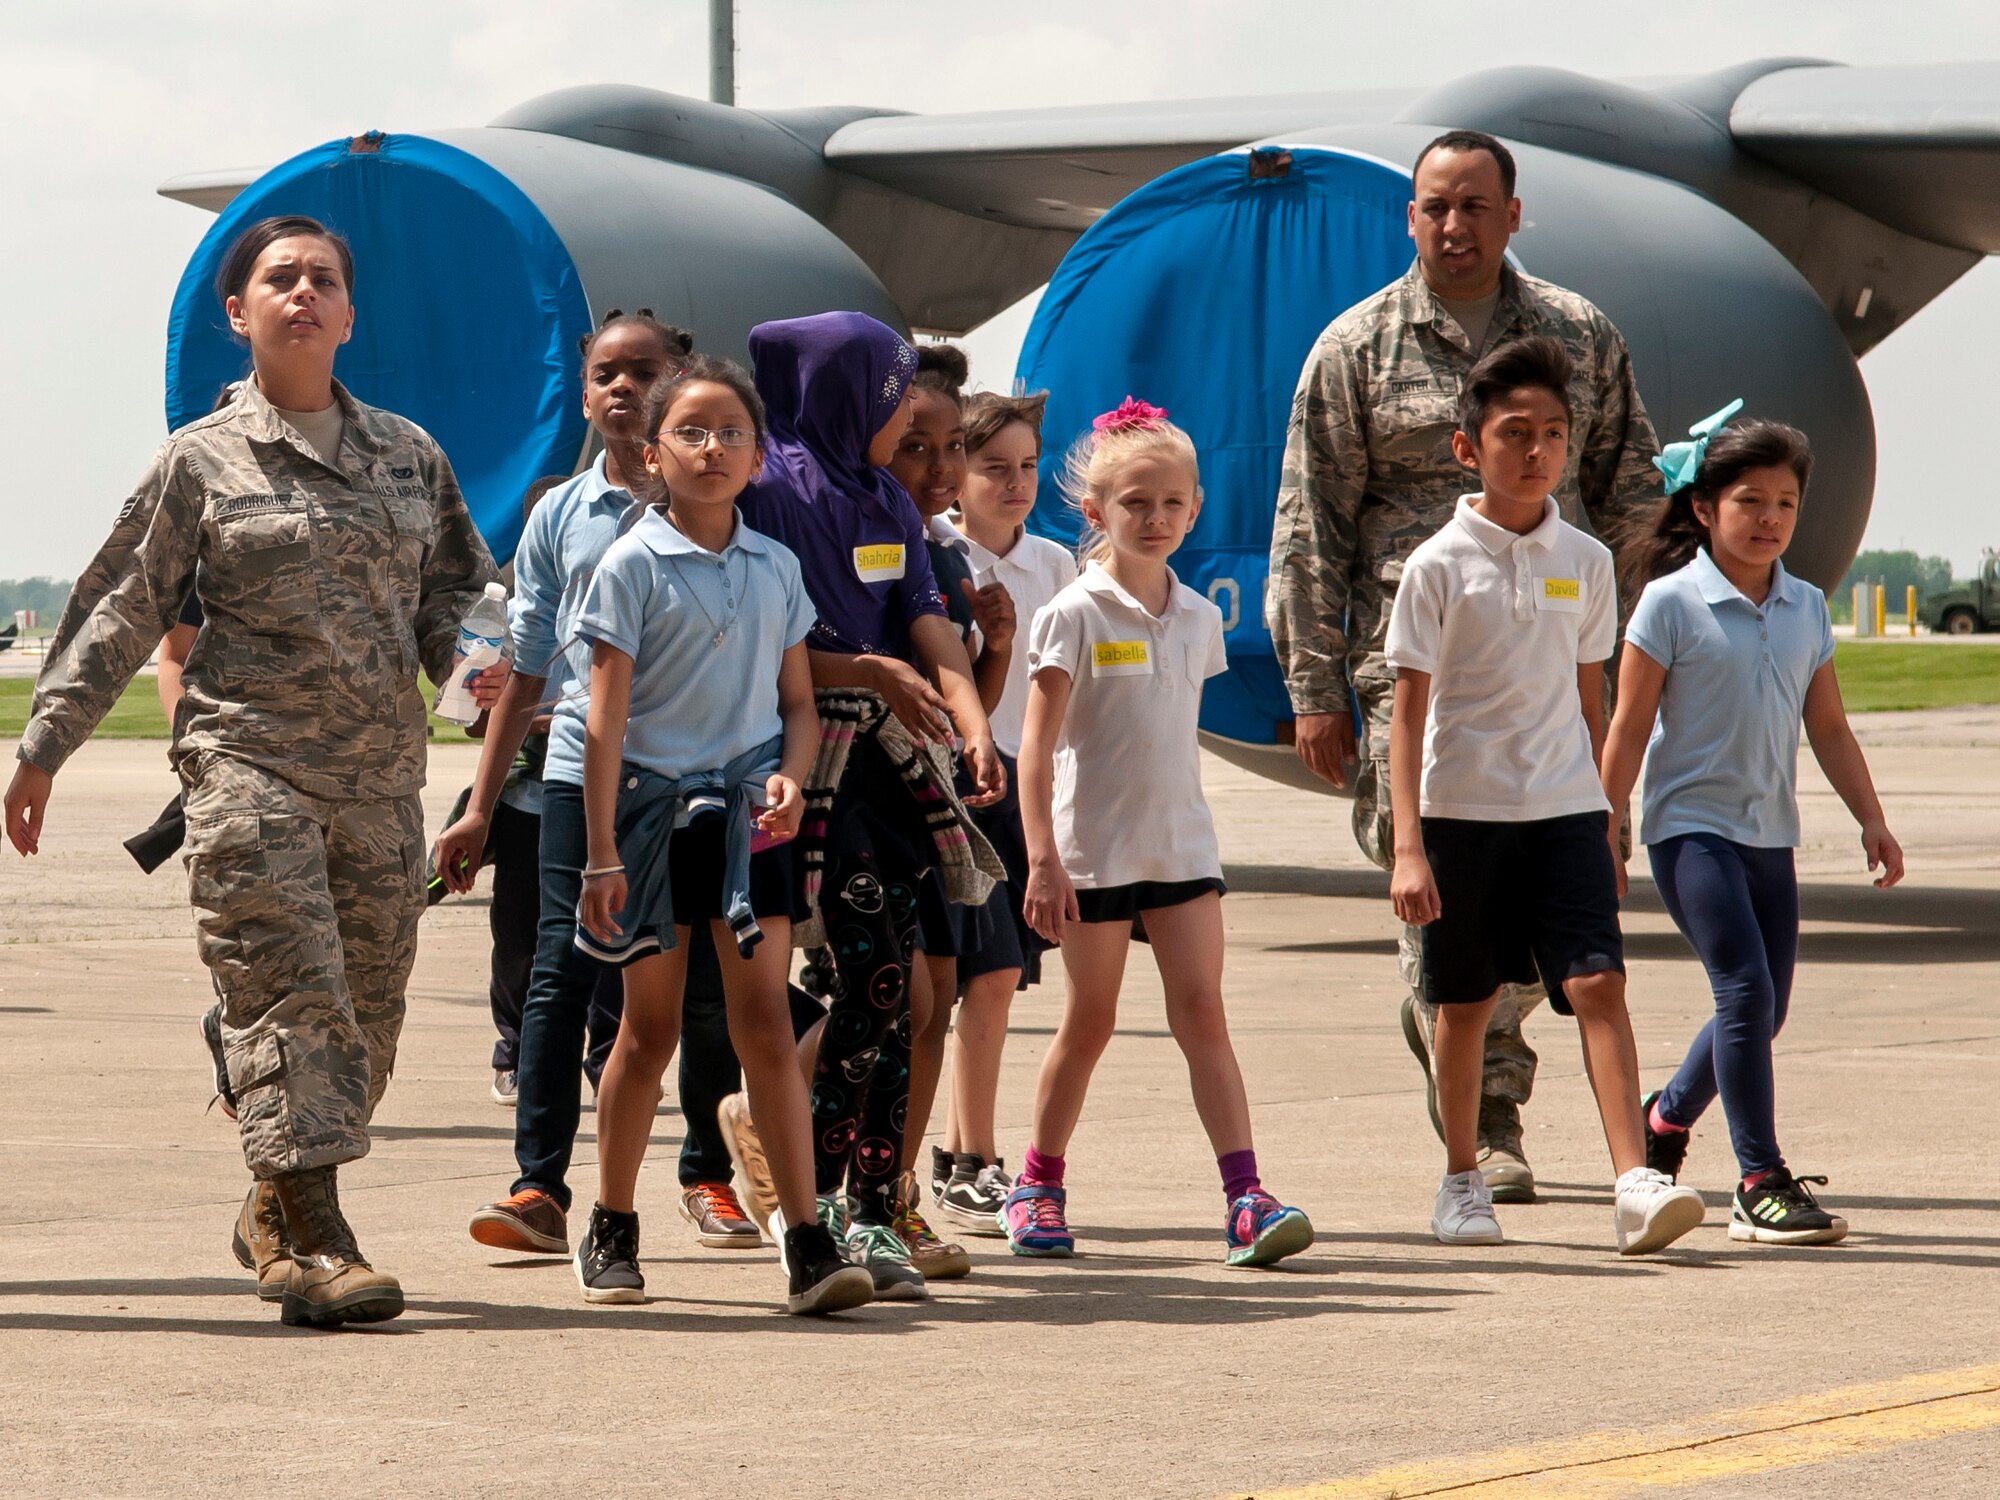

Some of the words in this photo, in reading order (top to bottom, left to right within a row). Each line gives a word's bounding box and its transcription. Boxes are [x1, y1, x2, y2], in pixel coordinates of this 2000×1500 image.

[1391, 380, 1428, 394] CARTER
[857, 550, 900, 567] Shahria
[1545, 582, 1579, 597] David
